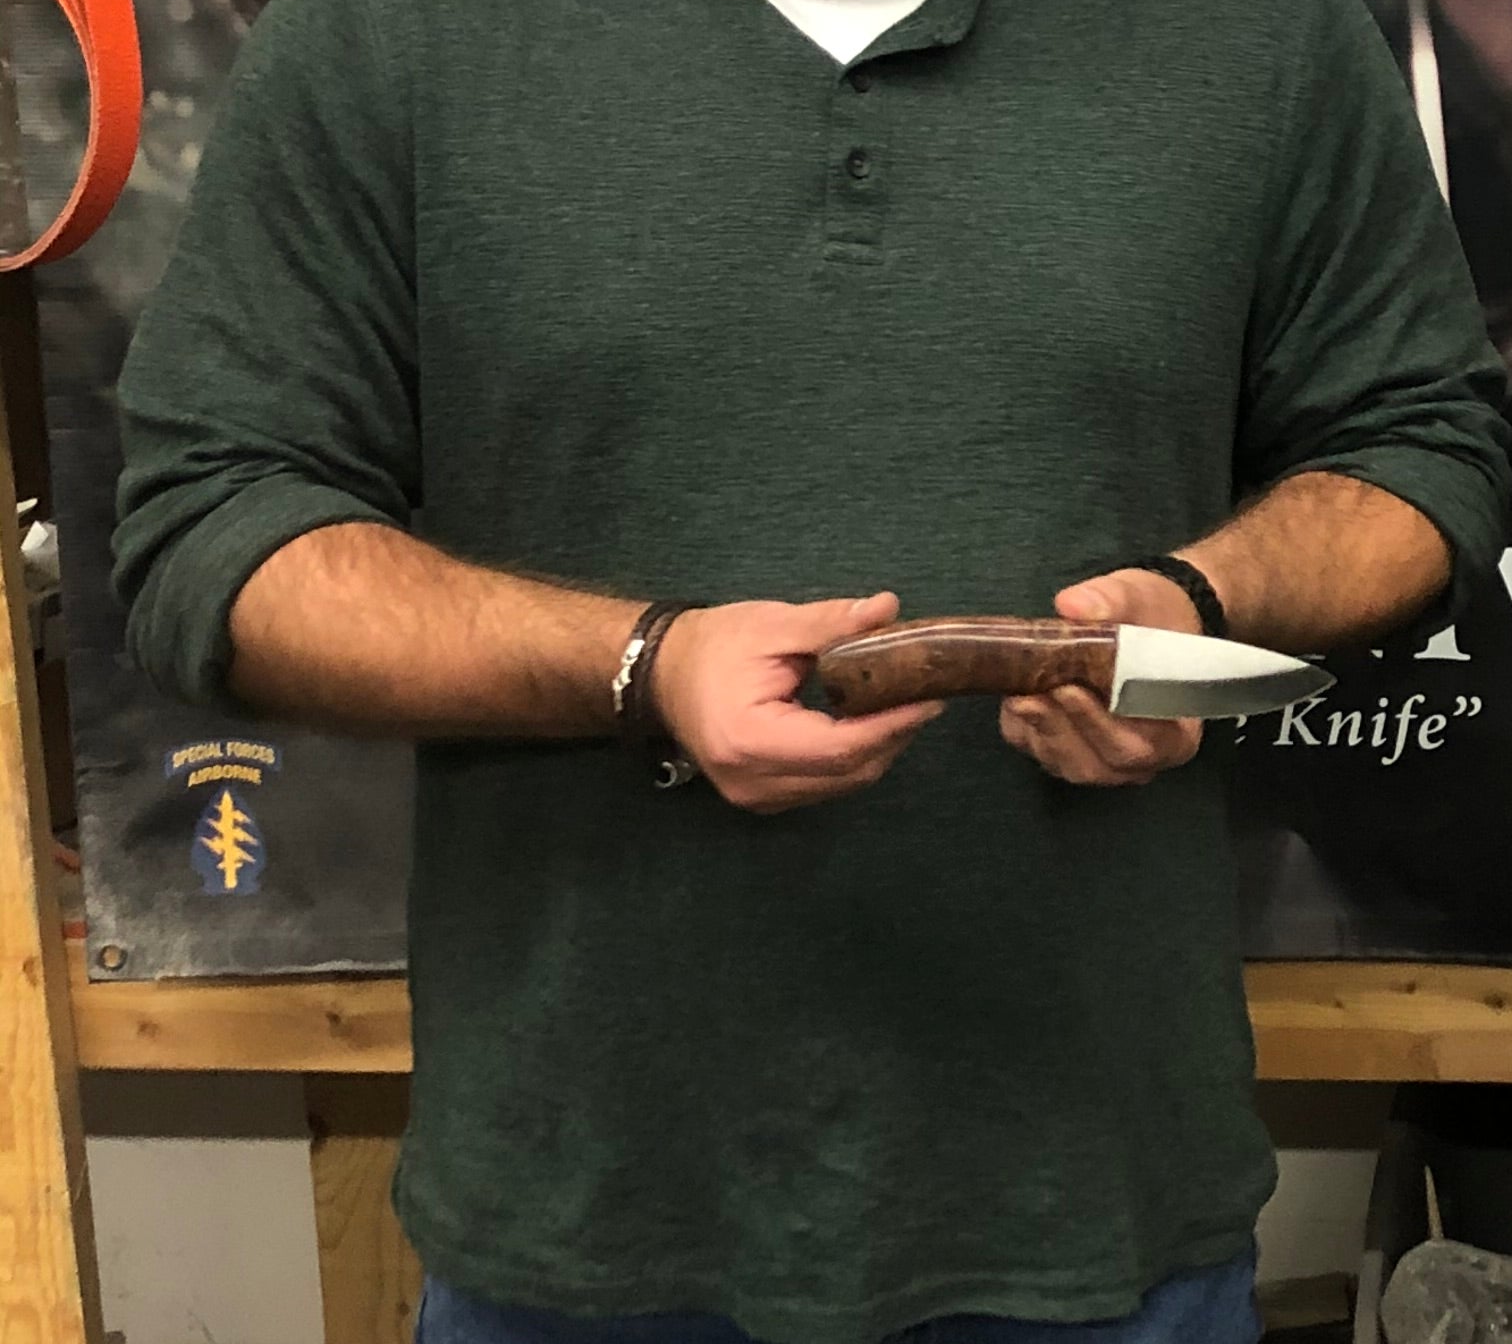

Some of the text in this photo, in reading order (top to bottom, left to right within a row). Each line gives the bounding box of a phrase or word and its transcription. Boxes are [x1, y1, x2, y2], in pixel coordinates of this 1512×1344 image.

[172, 740, 276, 769] SPECIAL FORCES
[187, 763, 263, 788] AIRBORNE
